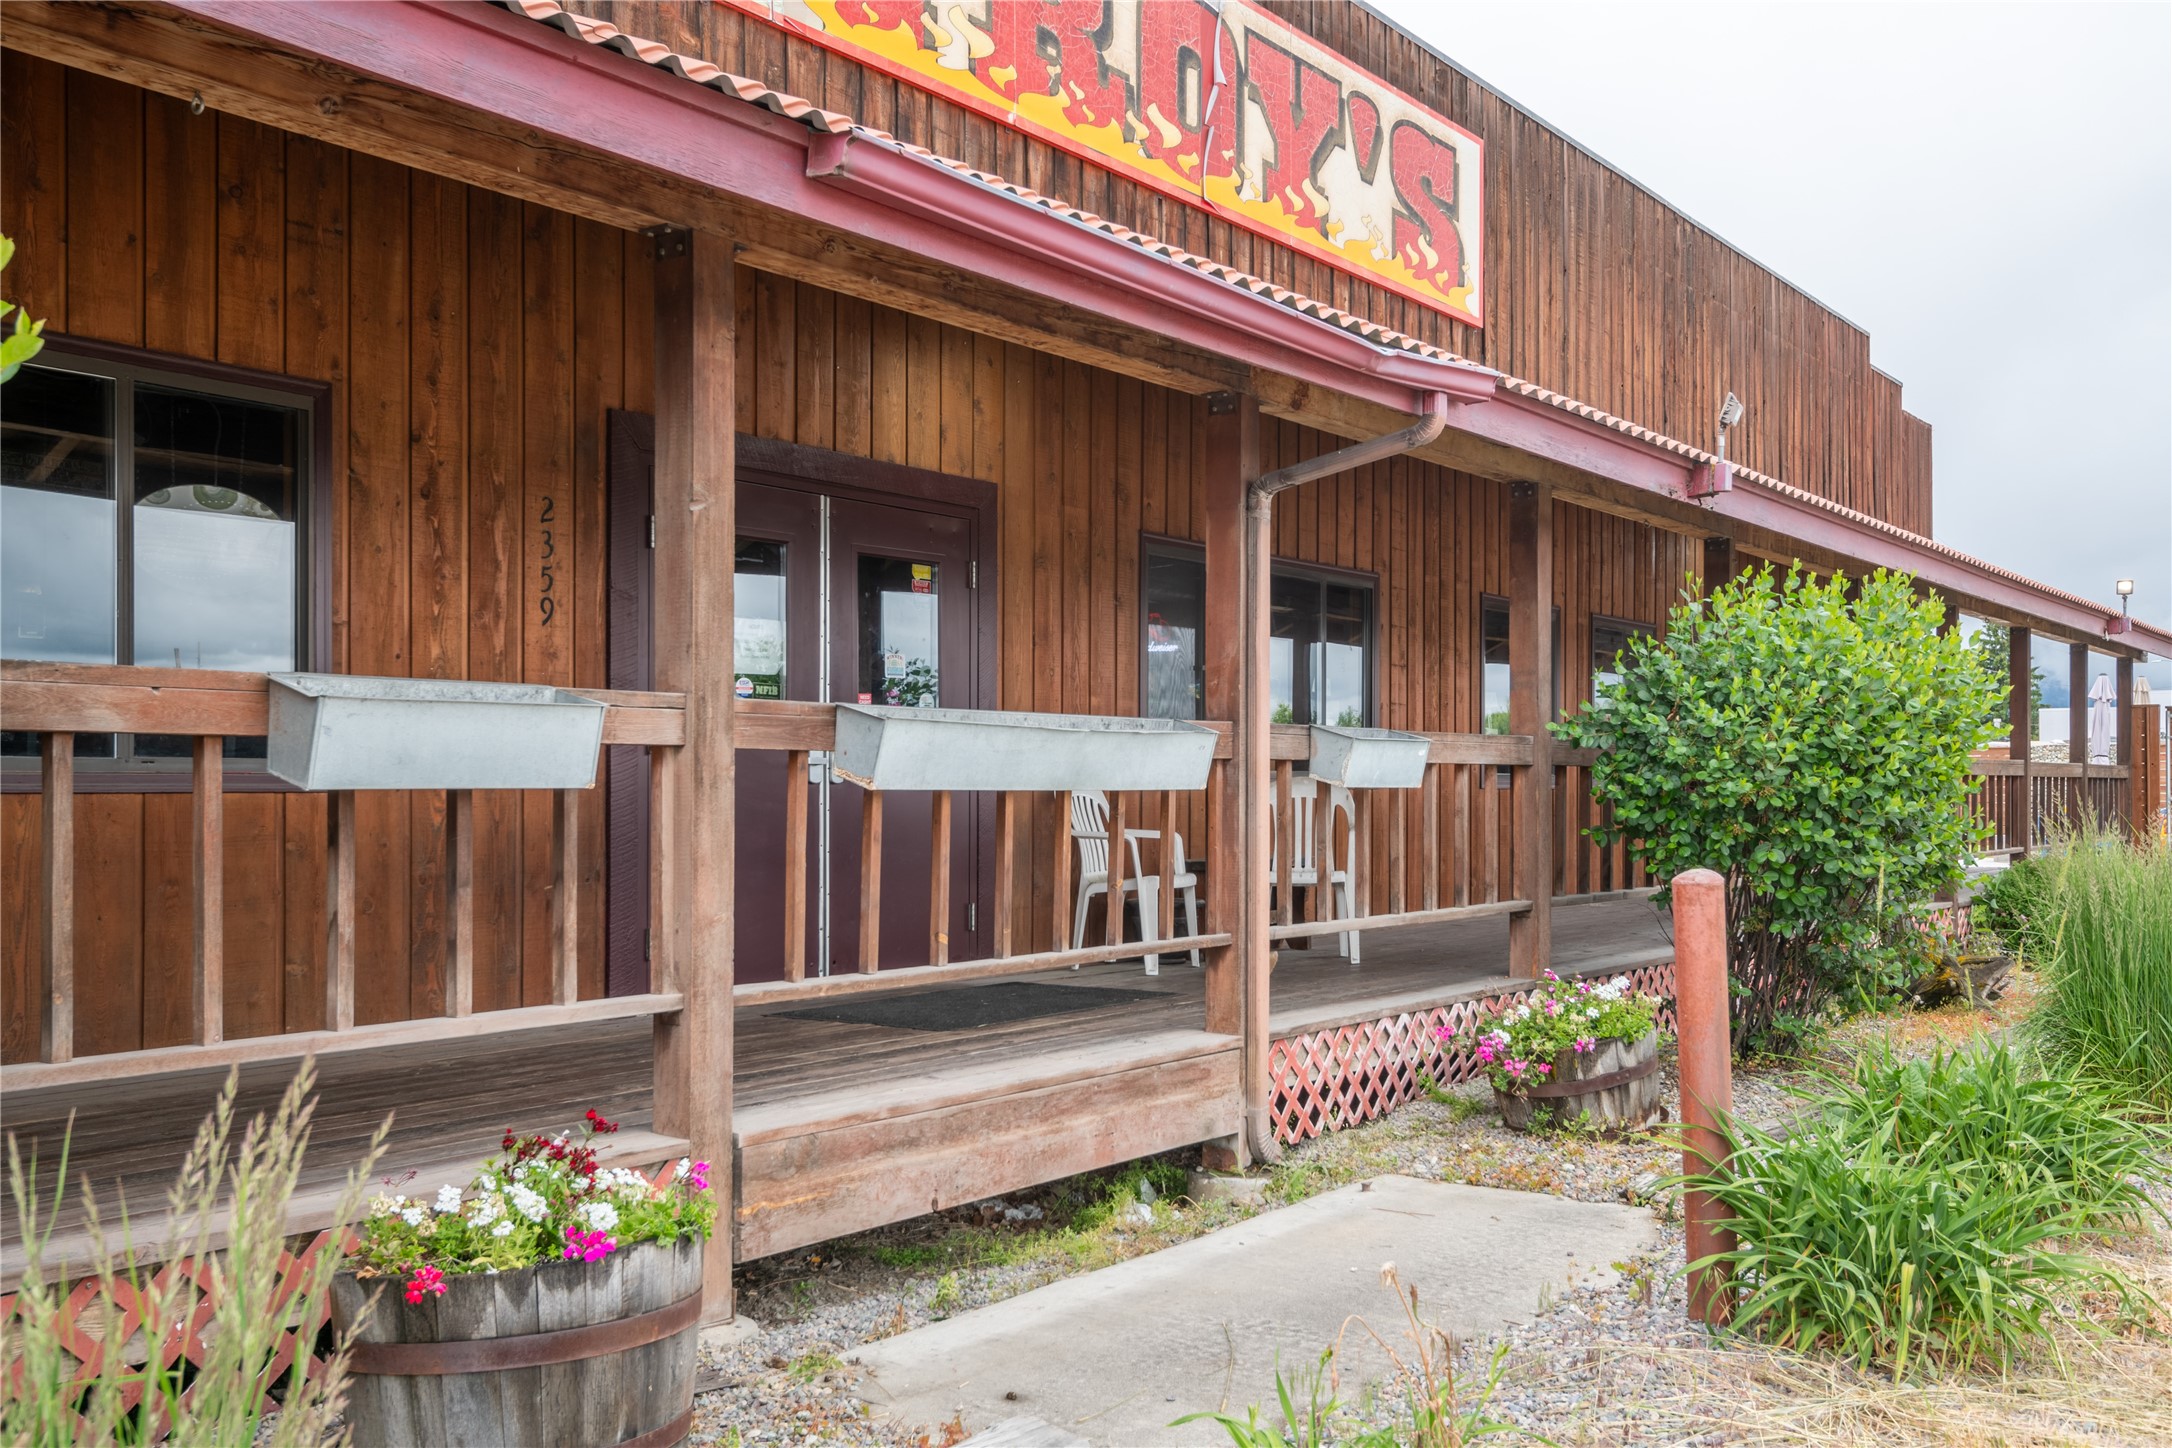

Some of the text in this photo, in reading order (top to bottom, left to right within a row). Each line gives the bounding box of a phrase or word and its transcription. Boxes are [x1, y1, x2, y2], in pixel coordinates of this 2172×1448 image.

[834, 0, 1467, 296] ROY'S
[540, 496, 554, 627] 2359
[755, 684, 779, 696] NFIB
